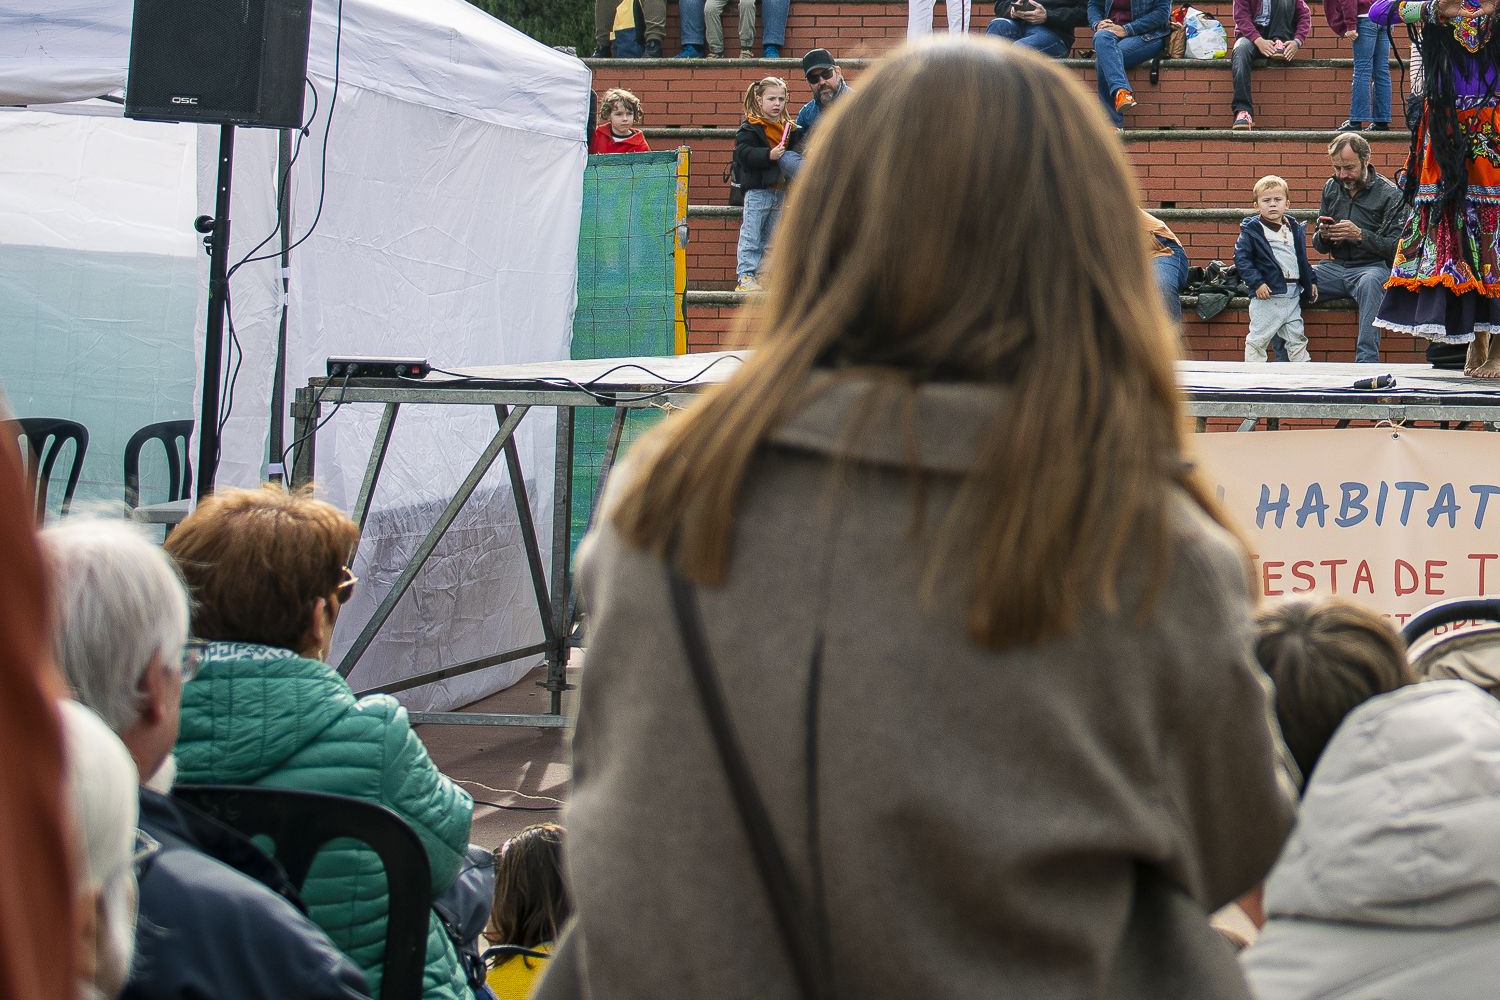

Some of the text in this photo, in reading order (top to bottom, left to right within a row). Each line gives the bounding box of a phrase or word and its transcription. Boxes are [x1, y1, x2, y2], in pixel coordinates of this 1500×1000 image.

[172, 96, 198, 105] QSC
[1252, 554, 1375, 596] ESTA
[1395, 558, 1448, 596] DE
